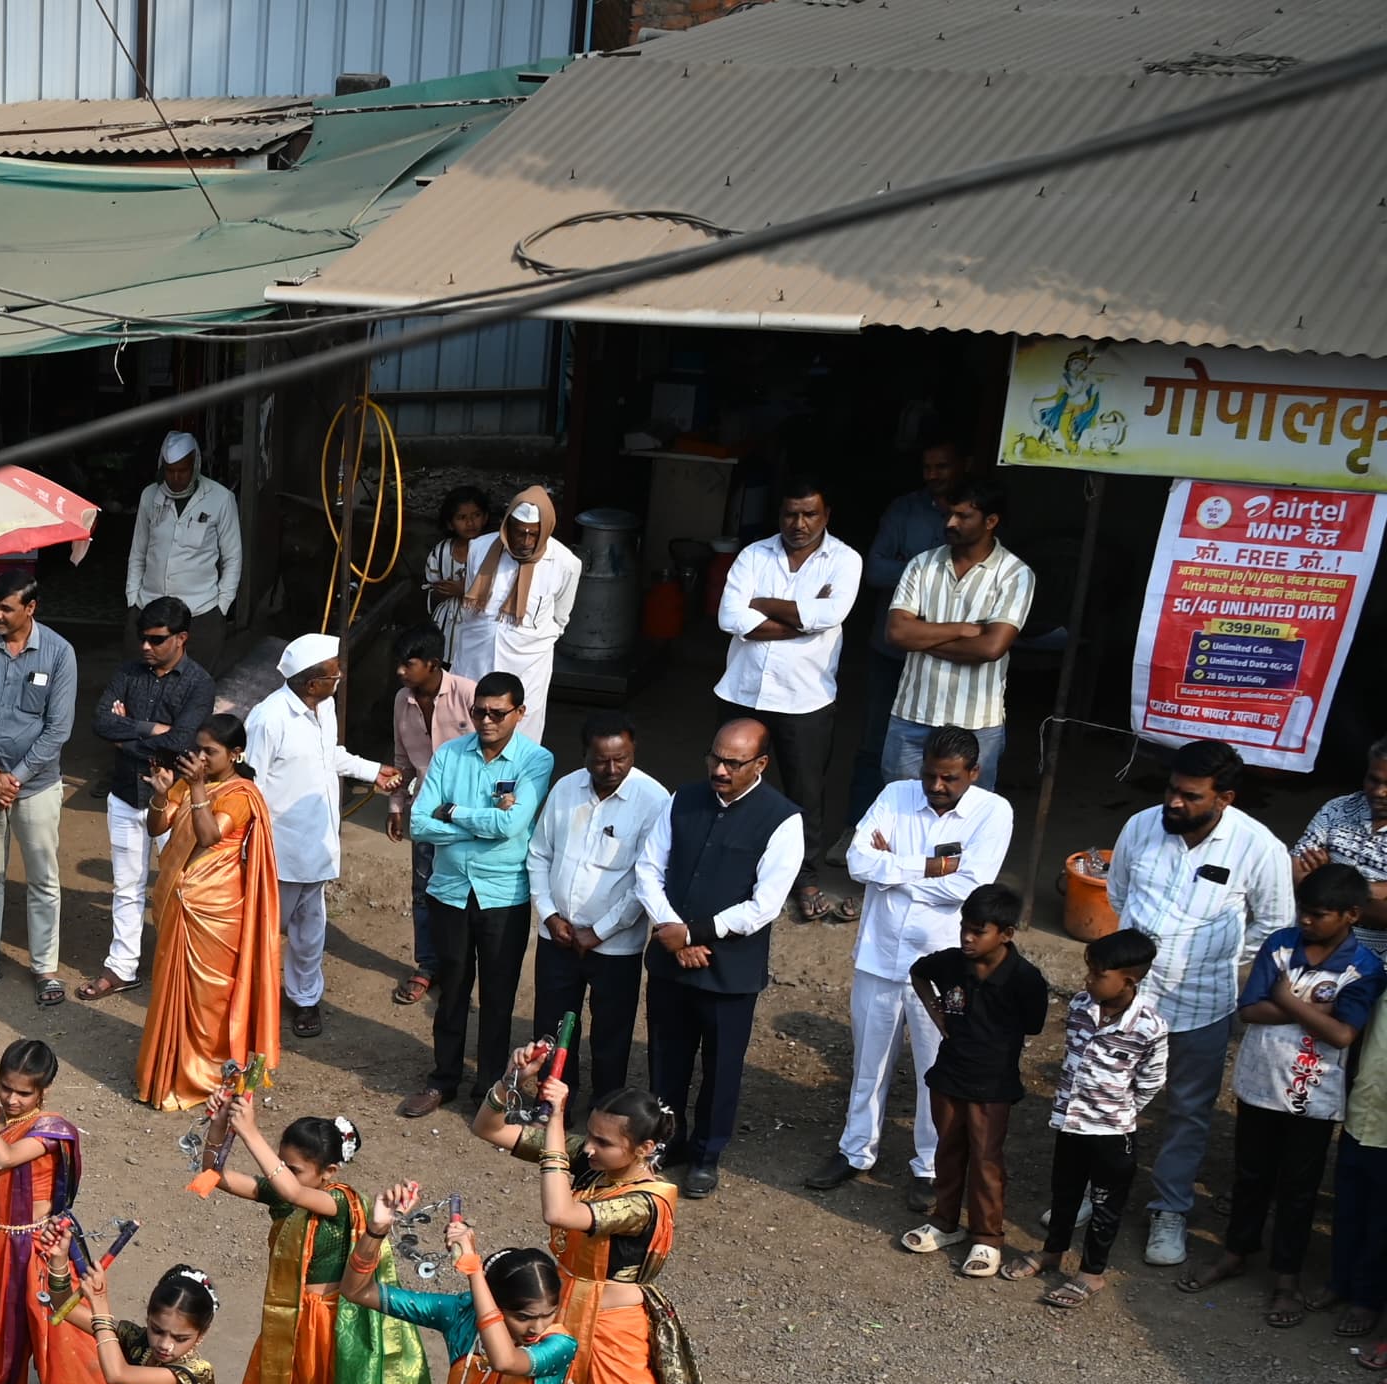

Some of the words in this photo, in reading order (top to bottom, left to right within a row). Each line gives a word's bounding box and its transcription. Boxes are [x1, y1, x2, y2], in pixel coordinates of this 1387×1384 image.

[1273, 496, 1347, 523] airtel
[1246, 522, 1303, 541] MNP
[1305, 523, 1341, 546] केंद्र
[1235, 548, 1289, 567] FREE
[1172, 596, 1217, 615] 5G/4G
[1219, 600, 1295, 618] UNLIMITED
[1297, 604, 1336, 620] DATA
[1218, 621, 1251, 634] ₹399
[1252, 624, 1279, 636] Plan
[1212, 641, 1251, 653] Unlimited
[1253, 645, 1273, 654] Calls
[1209, 656, 1247, 668] Unlimited
[1249, 659, 1268, 669] Data
[1269, 662, 1293, 672] 4G/5G
[1217, 672, 1236, 682] Days
[1236, 675, 1267, 685] Validity
